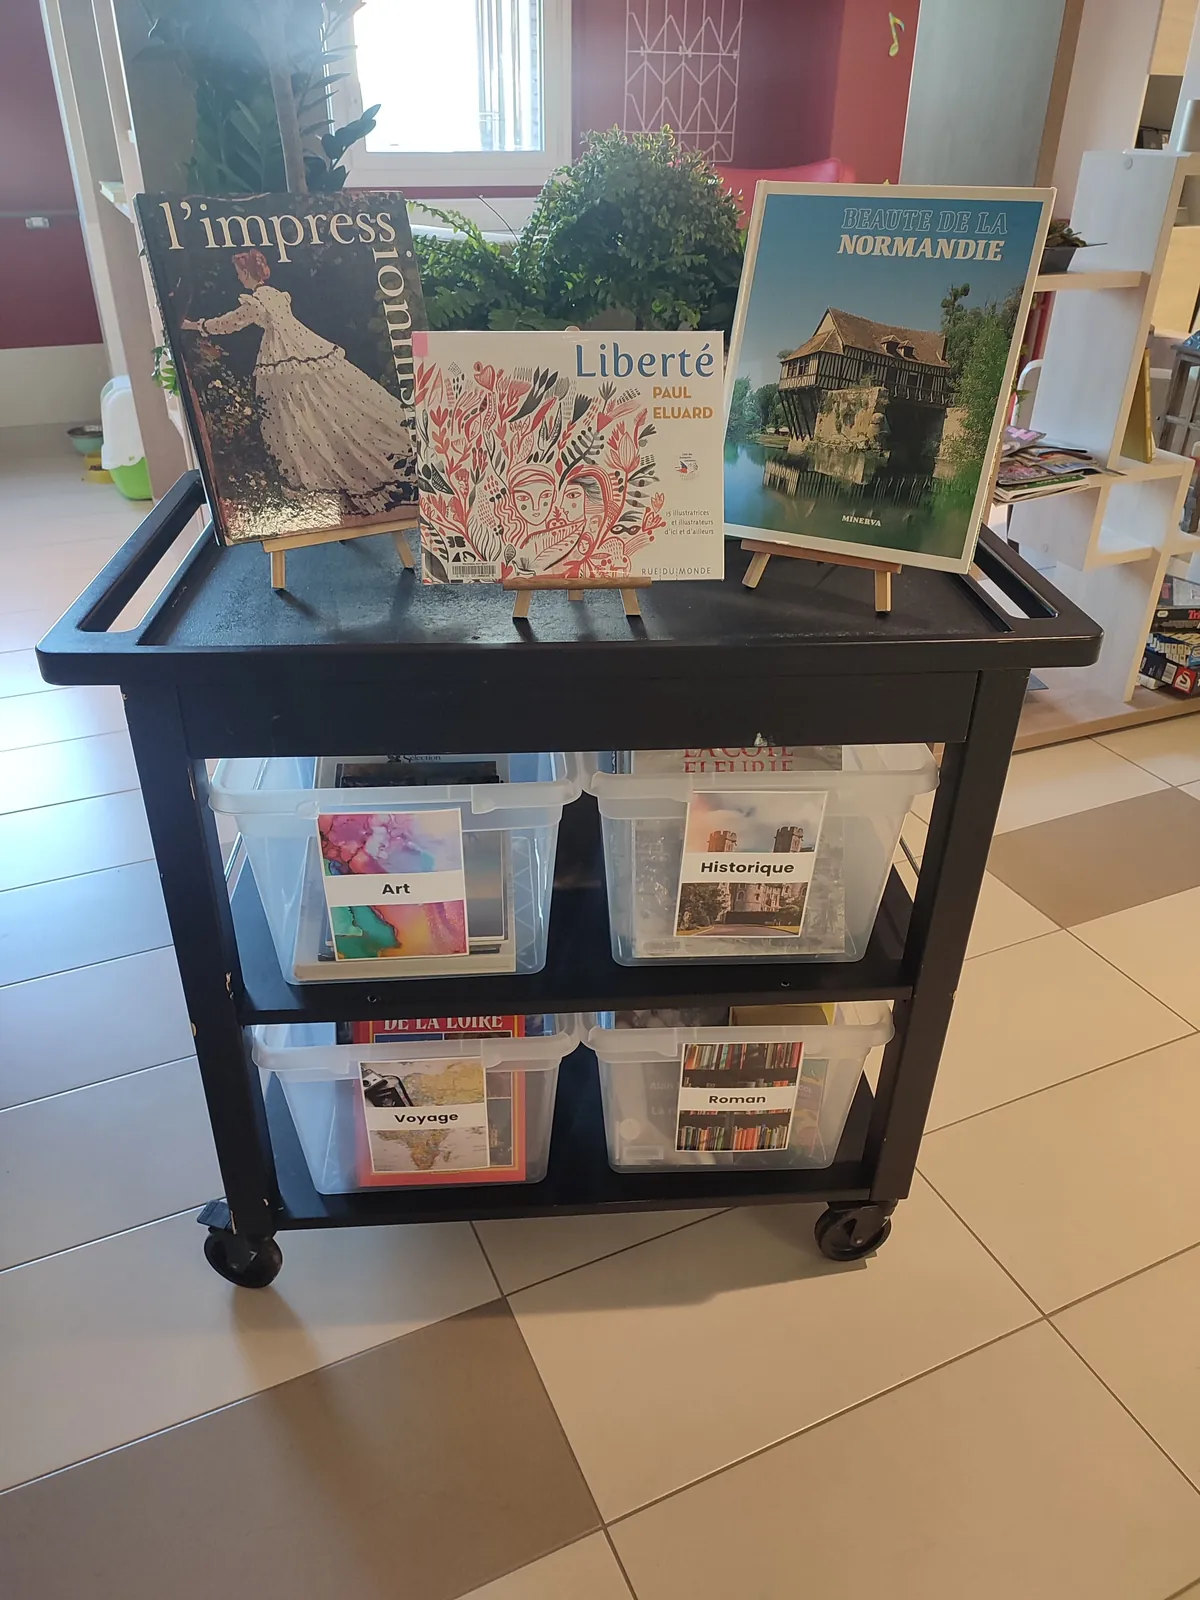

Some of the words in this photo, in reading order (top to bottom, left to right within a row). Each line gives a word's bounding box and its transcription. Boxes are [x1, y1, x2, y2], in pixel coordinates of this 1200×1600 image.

[841, 207, 934, 232] BEAUTE
[936, 211, 972, 234] DE
[975, 212, 1008, 235] LA
[837, 234, 1006, 262] NORMANDIE
[576, 342, 714, 378] Liberté
[652, 386, 692, 399] PAUL
[653, 406, 714, 419] ELUARD
[841, 515, 882, 527] MINERVA
[641, 567, 659, 576] RUE
[662, 567, 675, 575] DU
[678, 566, 711, 575] MONDE
[701, 861, 795, 877] Historique
[382, 883, 411, 895] Art
[708, 1095, 766, 1104] Roman
[394, 1113, 459, 1125] Voyage
